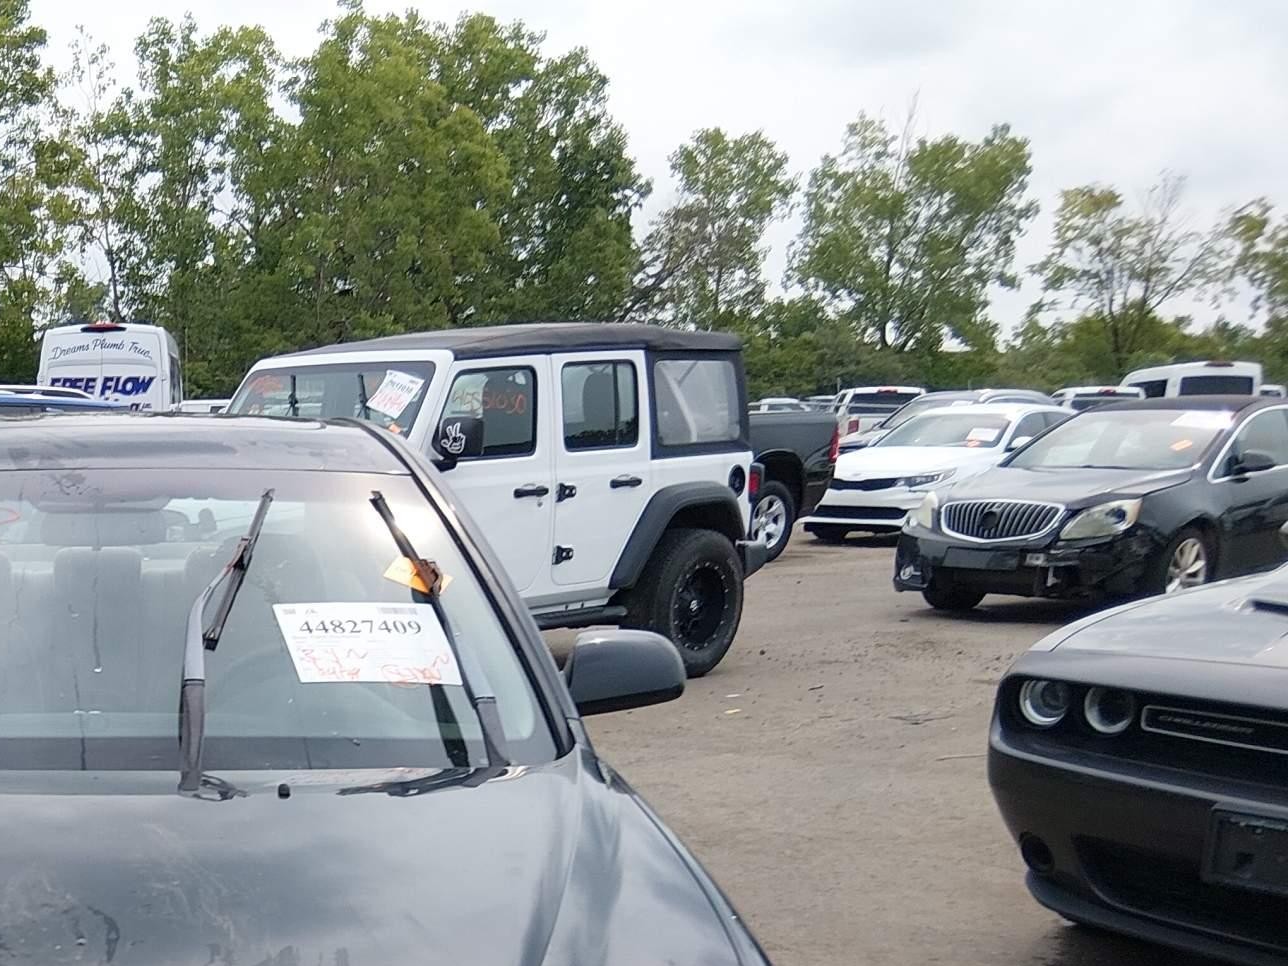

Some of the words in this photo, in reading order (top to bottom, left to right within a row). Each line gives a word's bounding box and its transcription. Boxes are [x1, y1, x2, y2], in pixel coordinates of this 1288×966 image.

[48, 343, 90, 360] Dreams
[92, 336, 124, 351] Plumb
[99, 376, 157, 397] FLOW
[298, 618, 423, 636] 44827409
